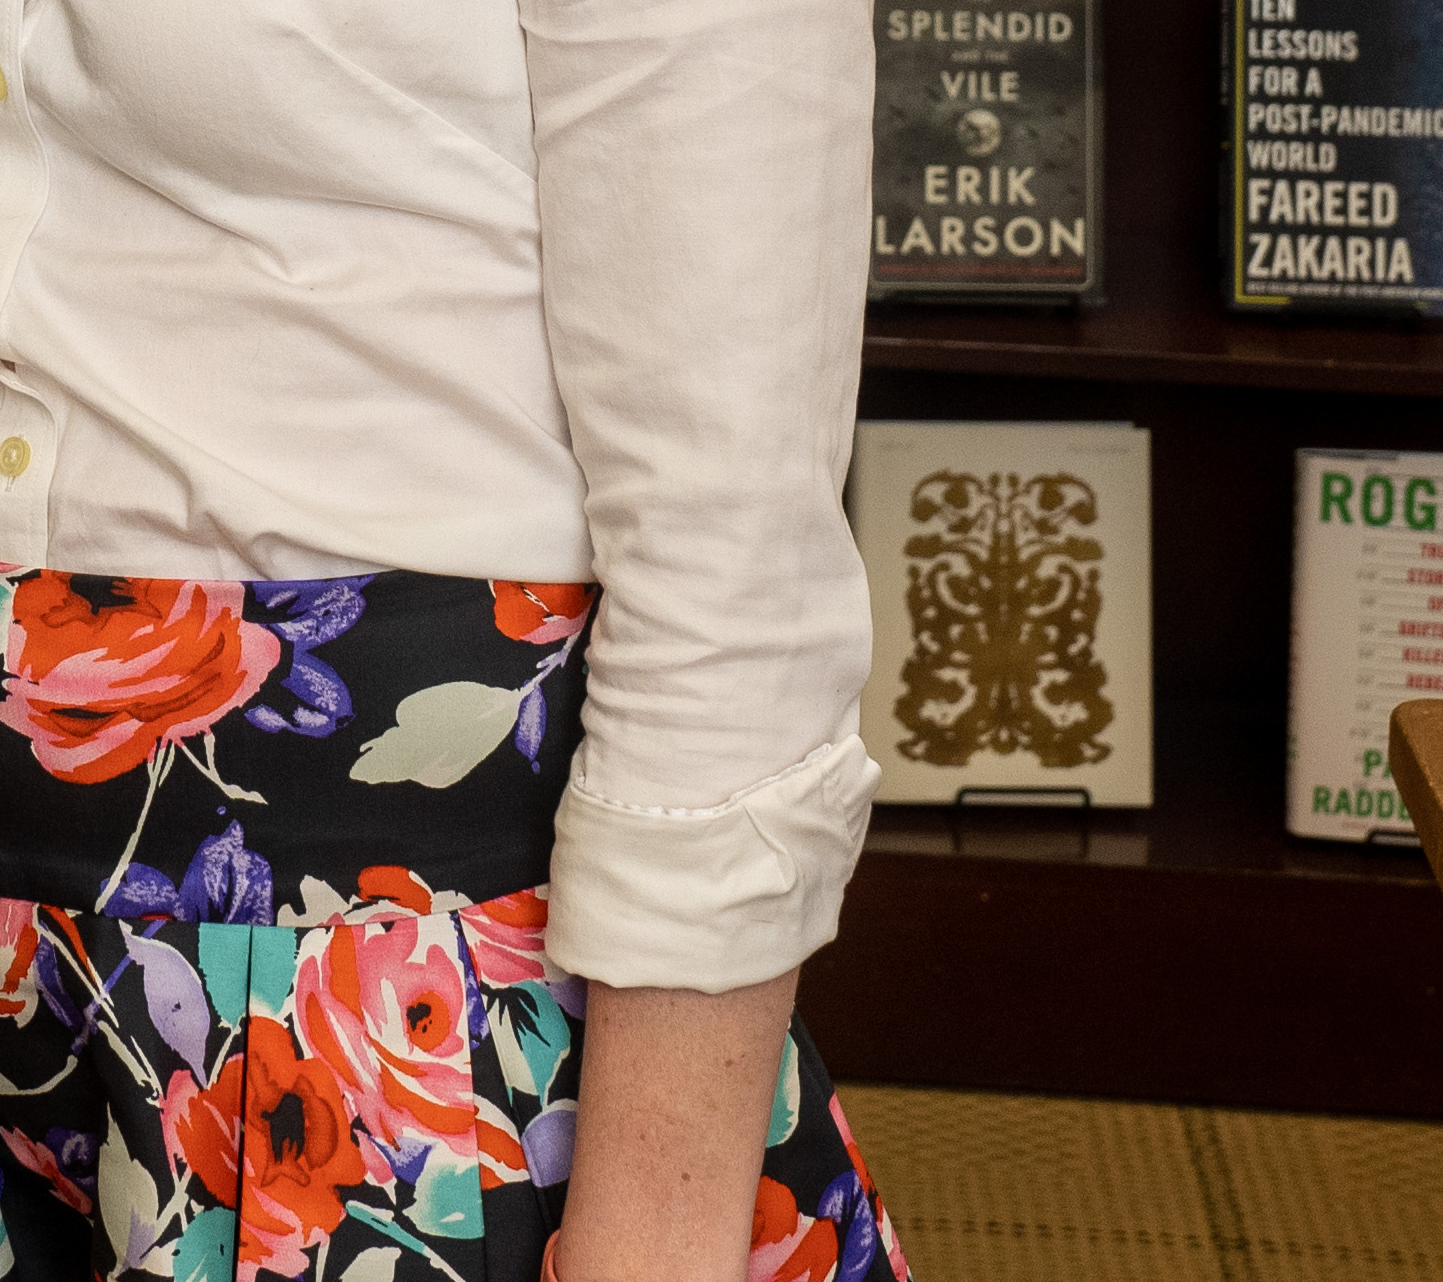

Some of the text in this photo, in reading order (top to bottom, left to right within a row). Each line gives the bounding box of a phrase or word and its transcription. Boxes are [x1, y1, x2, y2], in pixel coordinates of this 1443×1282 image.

[887, 8, 1073, 43] SPLENDID
[1247, 28, 1359, 62] LESSONS
[939, 69, 1020, 103] VILE
[1247, 66, 1324, 97] FOR A
[1247, 139, 1338, 172] WORLD
[924, 165, 1036, 206] ERIK
[1248, 180, 1399, 228] FAREED
[875, 215, 1085, 258] LARSON
[1248, 233, 1415, 284] ZAKARIA
